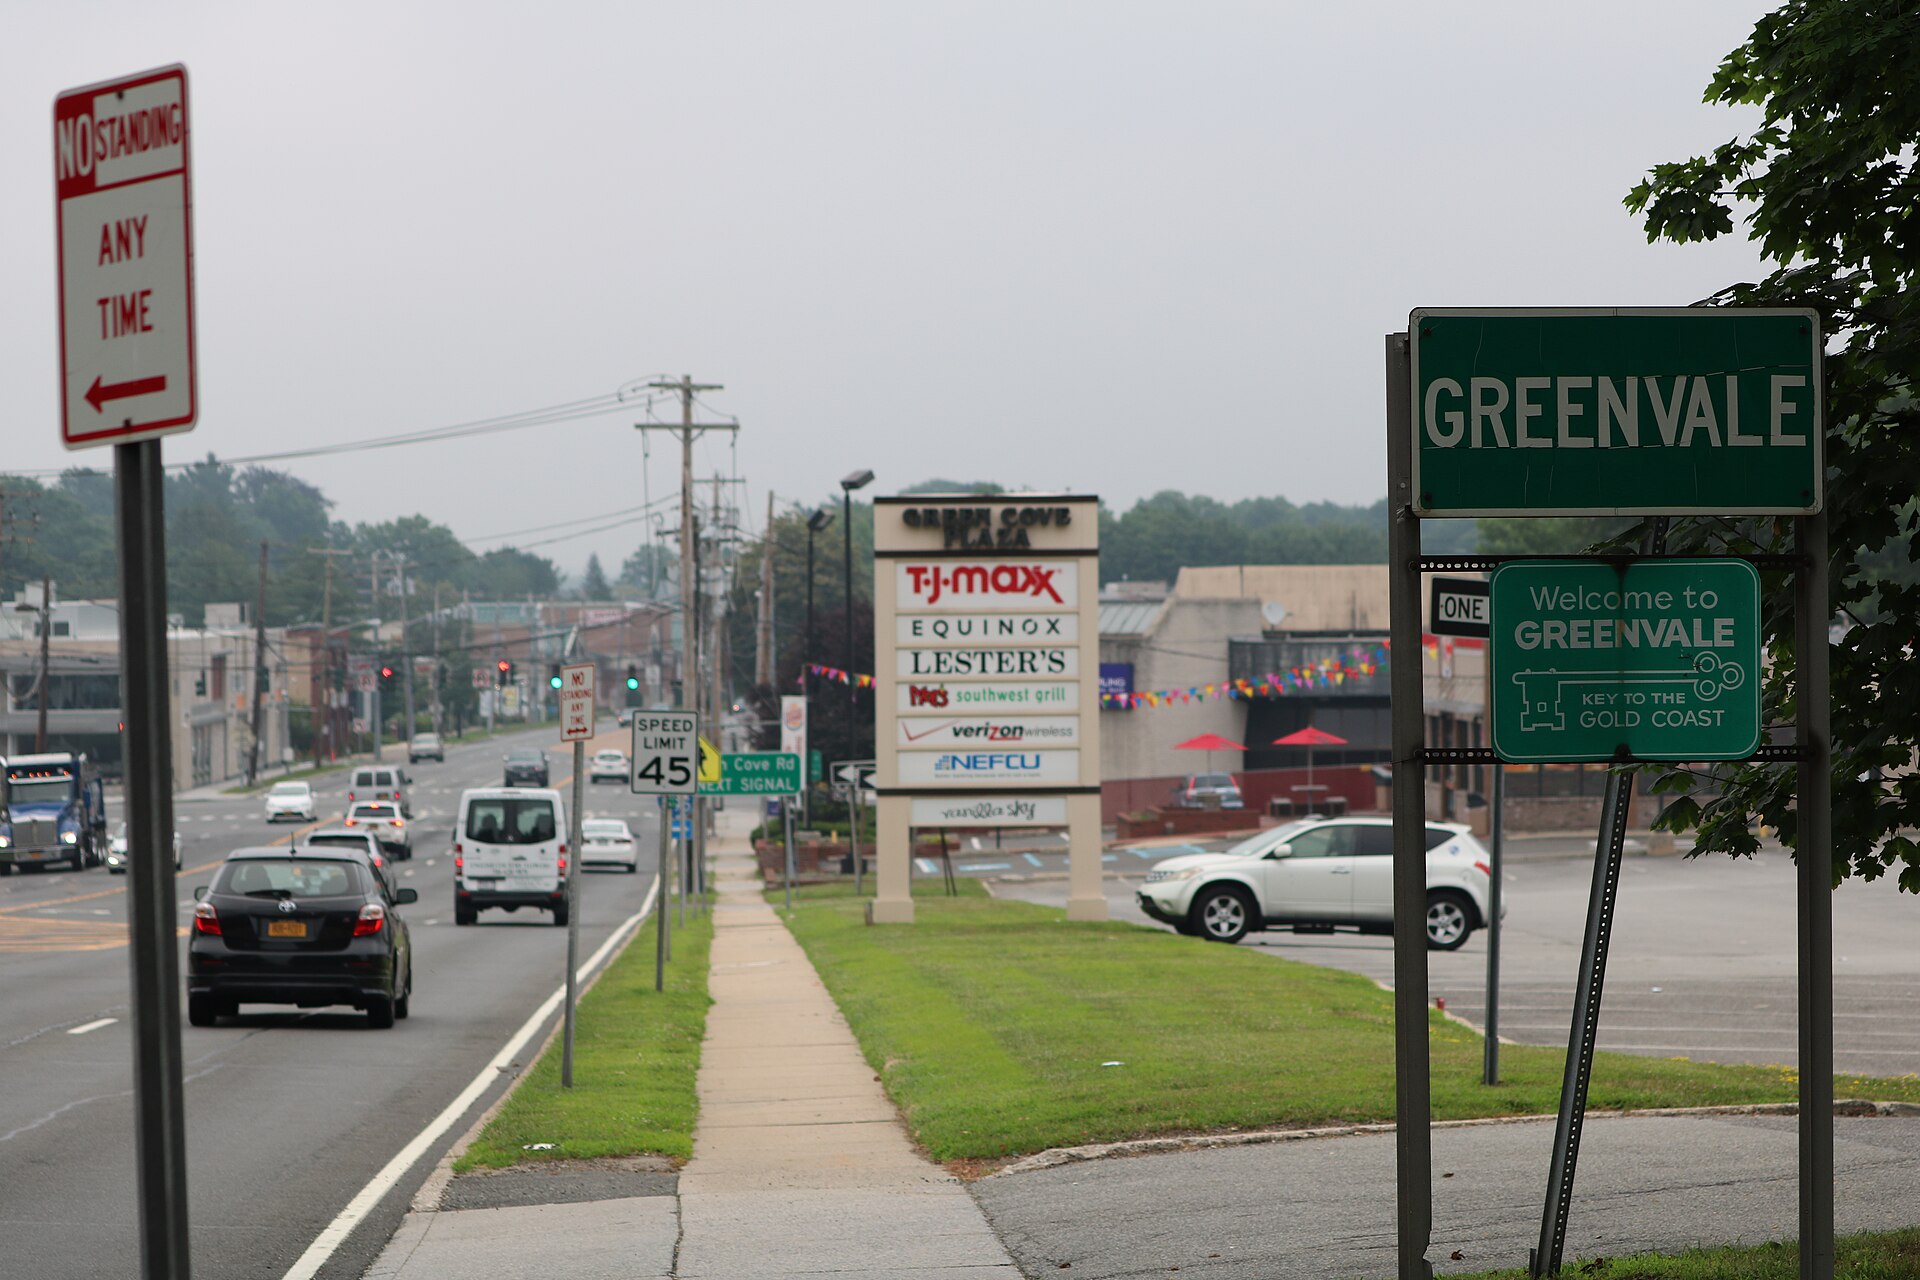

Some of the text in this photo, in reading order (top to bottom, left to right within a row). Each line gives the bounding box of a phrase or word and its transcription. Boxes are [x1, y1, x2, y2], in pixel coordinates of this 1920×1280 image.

[57, 102, 182, 181] NO STANDING
[97, 213, 149, 267] ANY
[97, 288, 154, 340] TIME
[1424, 374, 1807, 448] GREENVALE
[902, 506, 1072, 528] GREEN COVE
[944, 527, 1031, 547] PLAZA
[1444, 595, 1484, 620] ONE
[1529, 585, 1719, 611] Welcome to
[912, 618, 1061, 638] EQUINOX
[1514, 617, 1735, 650] GREENVALE
[910, 650, 1066, 675] LESTER'S
[571, 671, 585, 686] NO
[562, 688, 592, 700] STANDING
[956, 686, 1030, 703] southwest
[1035, 687, 1066, 703] grill
[1582, 692, 1686, 705] KEY TO THE
[571, 703, 584, 713] ANY
[570, 715, 585, 726] TIME
[638, 718, 694, 733] SPEED
[1579, 709, 1725, 728] GOLD COAST
[952, 722, 1073, 741] verizon wireless
[643, 737, 687, 750] LIMIT
[637, 755, 692, 787] 45
[734, 757, 770, 771] Cove
[776, 757, 795, 770] Rd
[951, 754, 1041, 770] NEFCU
[698, 777, 796, 792] NEXT SIGNAL
